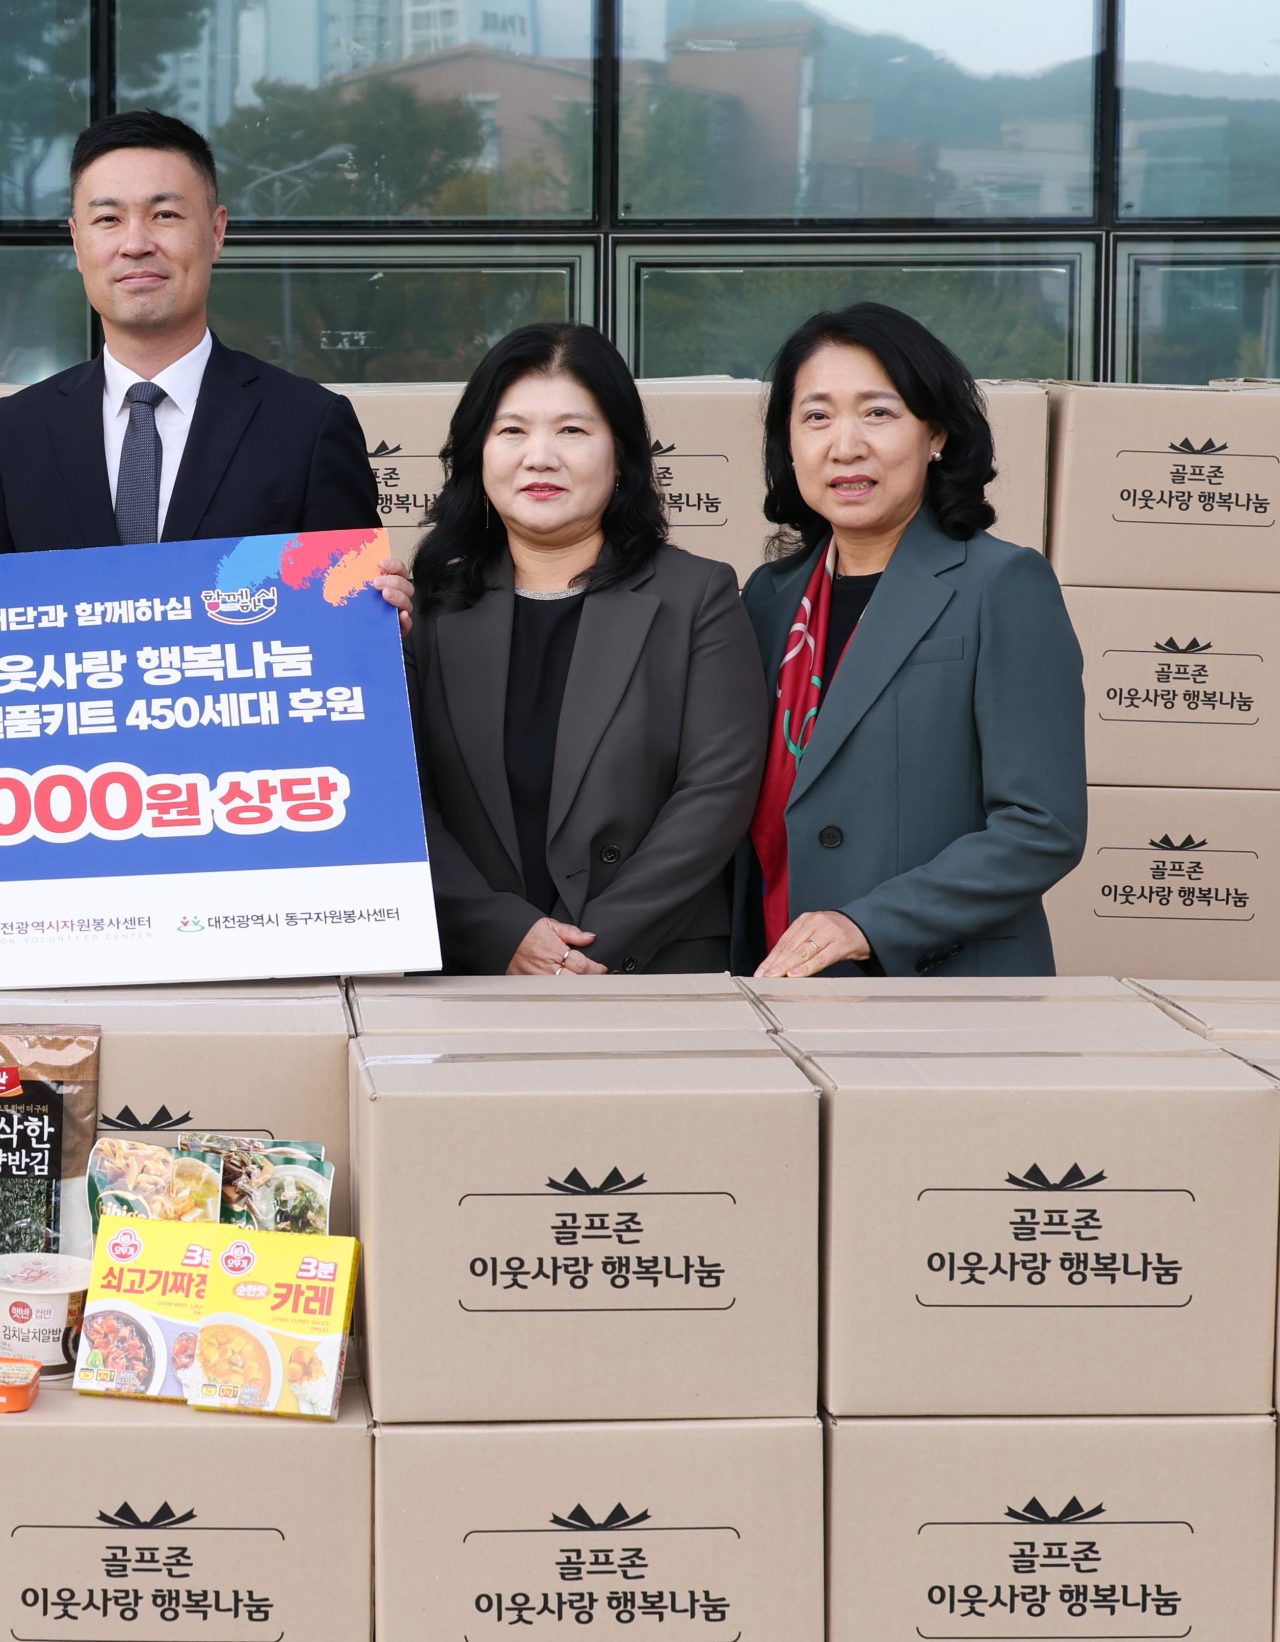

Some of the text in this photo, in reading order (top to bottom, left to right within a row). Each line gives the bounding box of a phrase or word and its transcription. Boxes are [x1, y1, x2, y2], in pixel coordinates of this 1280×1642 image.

[1169, 463, 1225, 486] 골프존
[377, 493, 437, 514] 행복나
[662, 493, 722, 513] 복나눔
[1119, 488, 1271, 514] 이웃사랑 행복나눔
[74, 595, 192, 627] 함께하심
[136, 640, 313, 684] 행복나눔
[1154, 662, 1209, 685] 골프존
[125, 690, 280, 731] 450세대
[288, 686, 366, 723] 후원
[1106, 687, 1255, 712] 이웃사랑 행복나눔
[219, 776, 338, 825] 상당
[1149, 860, 1205, 881] 골프존
[1101, 884, 1250, 908] 이웃사랑 행복나눔
[207, 907, 400, 930] 대전광역시 동구자원봉사센터
[550, 1212, 644, 1246] 골프존
[1008, 1208, 1103, 1242] 골프존
[296, 1257, 337, 1282] 3분
[469, 1255, 726, 1290] 이웃사랑 행복나눔
[927, 1251, 1183, 1286] 이웃사랑 행복나눔
[236, 1283, 268, 1297] 순한맛
[271, 1282, 335, 1316] 카레
[11, 1307, 31, 1319] 햇반
[2, 1325, 63, 1343] 김치날치알밥
[100, 1545, 194, 1579] 골프존
[555, 1547, 649, 1582] 골프존
[1008, 1541, 1102, 1574] 골프존
[20, 1587, 274, 1623] 이웃사랑 행복나눔
[474, 1589, 731, 1626] 이웃사랑 행복나눔
[927, 1583, 1182, 1618] 이웃사랑 행복나눔
